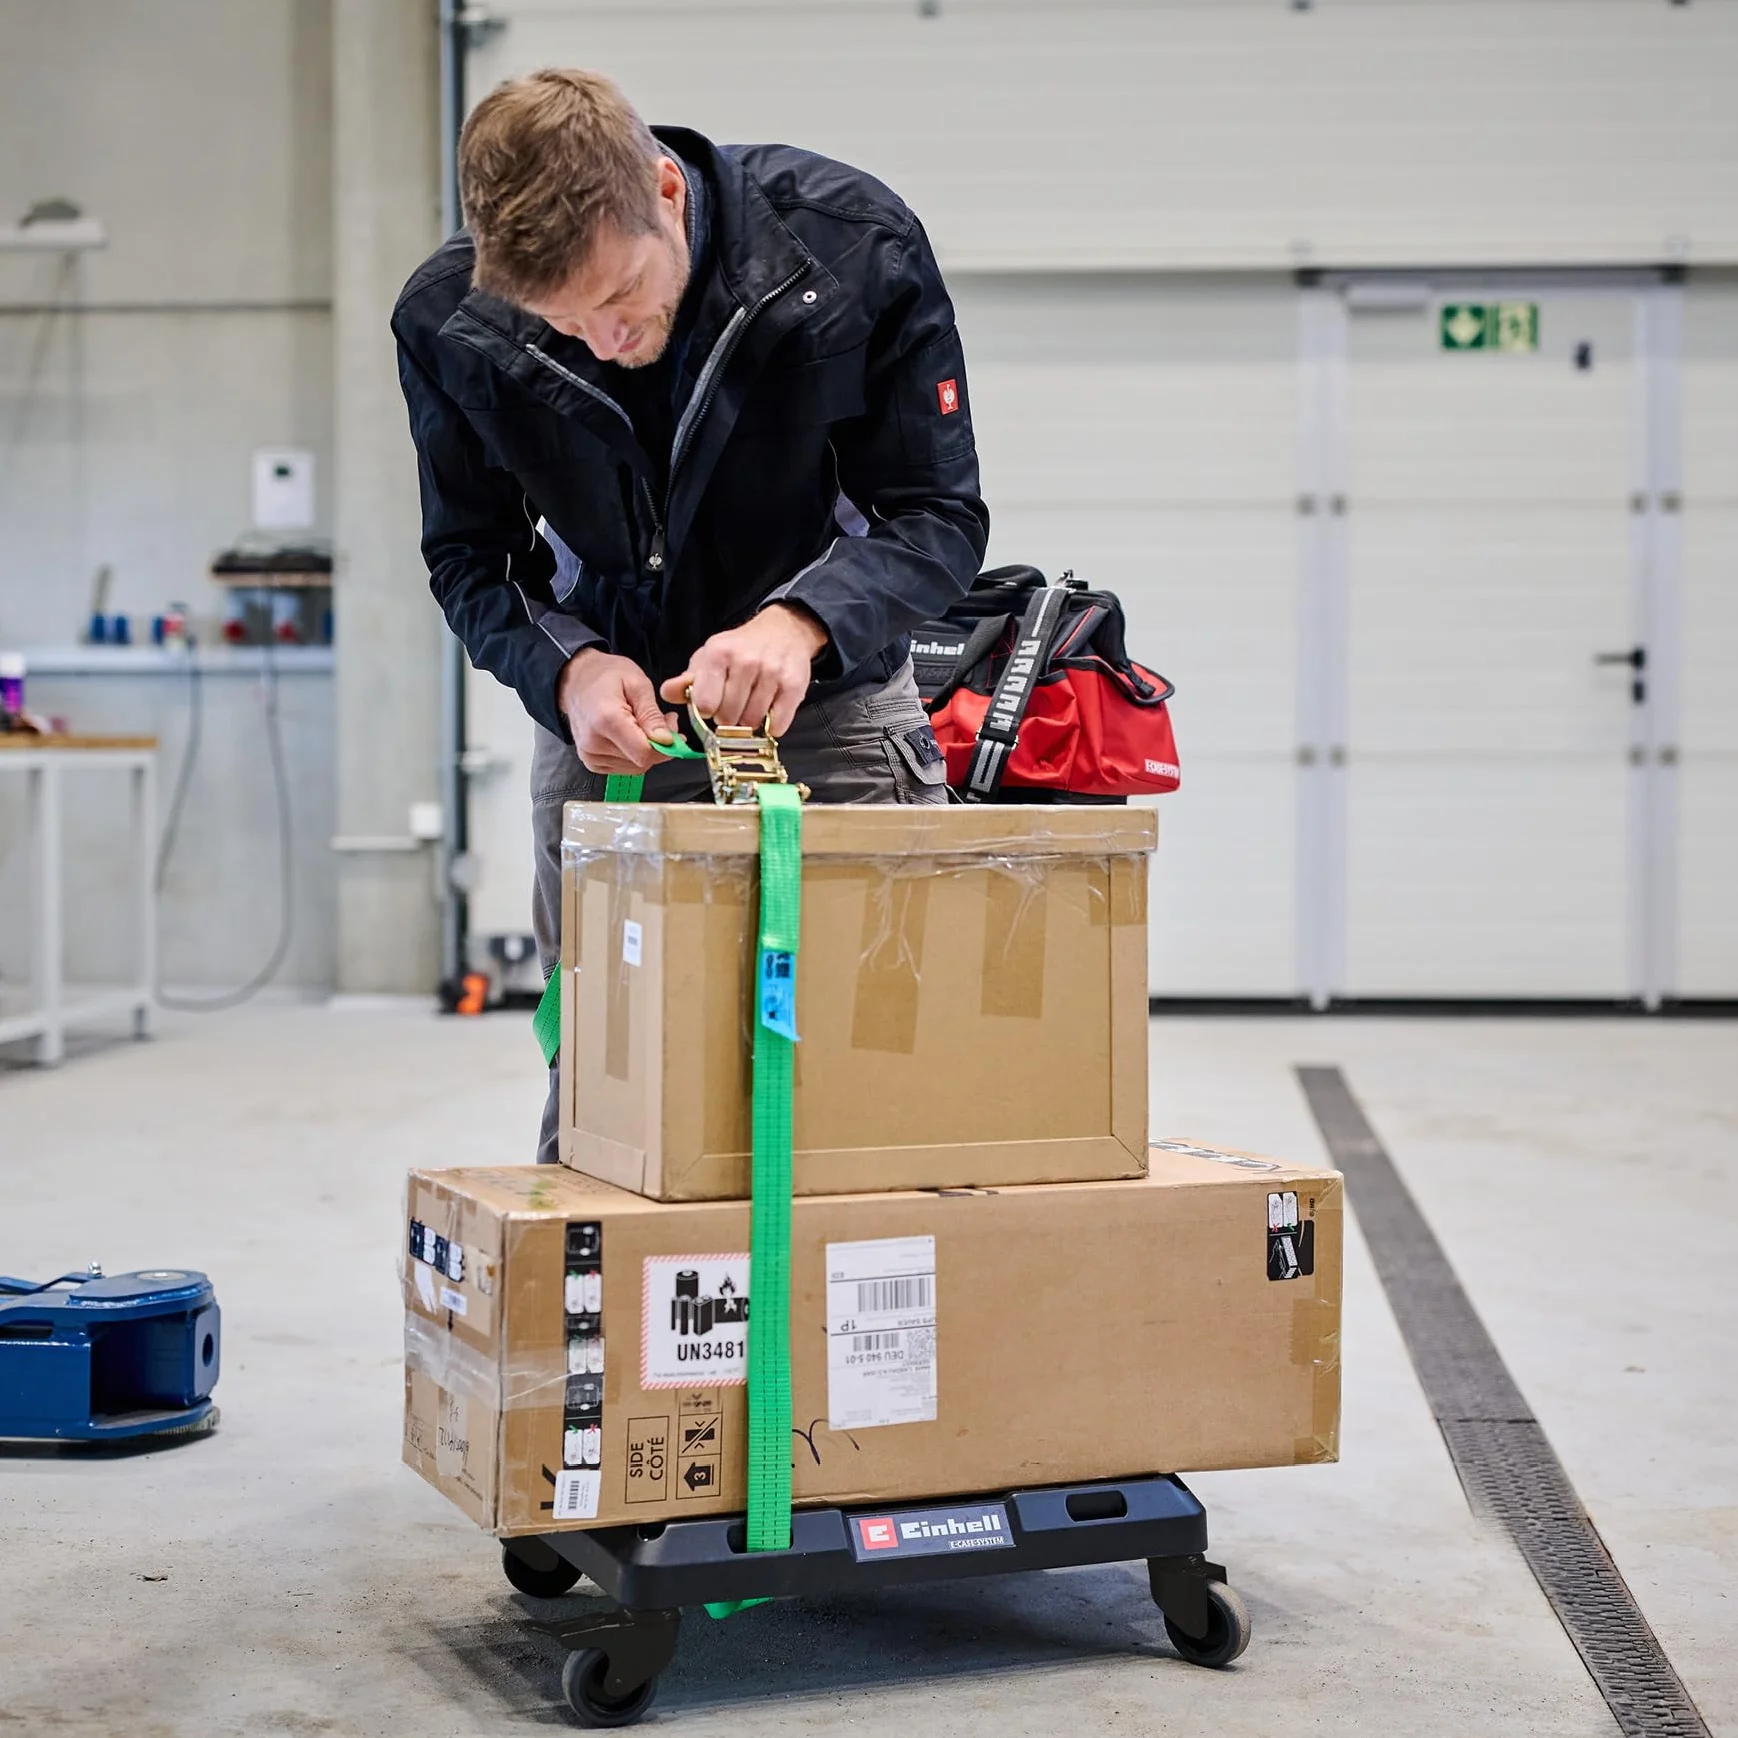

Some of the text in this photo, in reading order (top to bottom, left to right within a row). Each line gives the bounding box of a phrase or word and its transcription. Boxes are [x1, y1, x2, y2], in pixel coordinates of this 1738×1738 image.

[840, 1320, 857, 1332] 1P
[677, 1341, 744, 1362] UN3481
[884, 1350, 904, 1361] DEU
[629, 1441, 644, 1478] SIDE
[646, 1436, 664, 1481] CÔTÉ
[694, 1471, 706, 1481] 3
[900, 1514, 1002, 1539] Einhell
